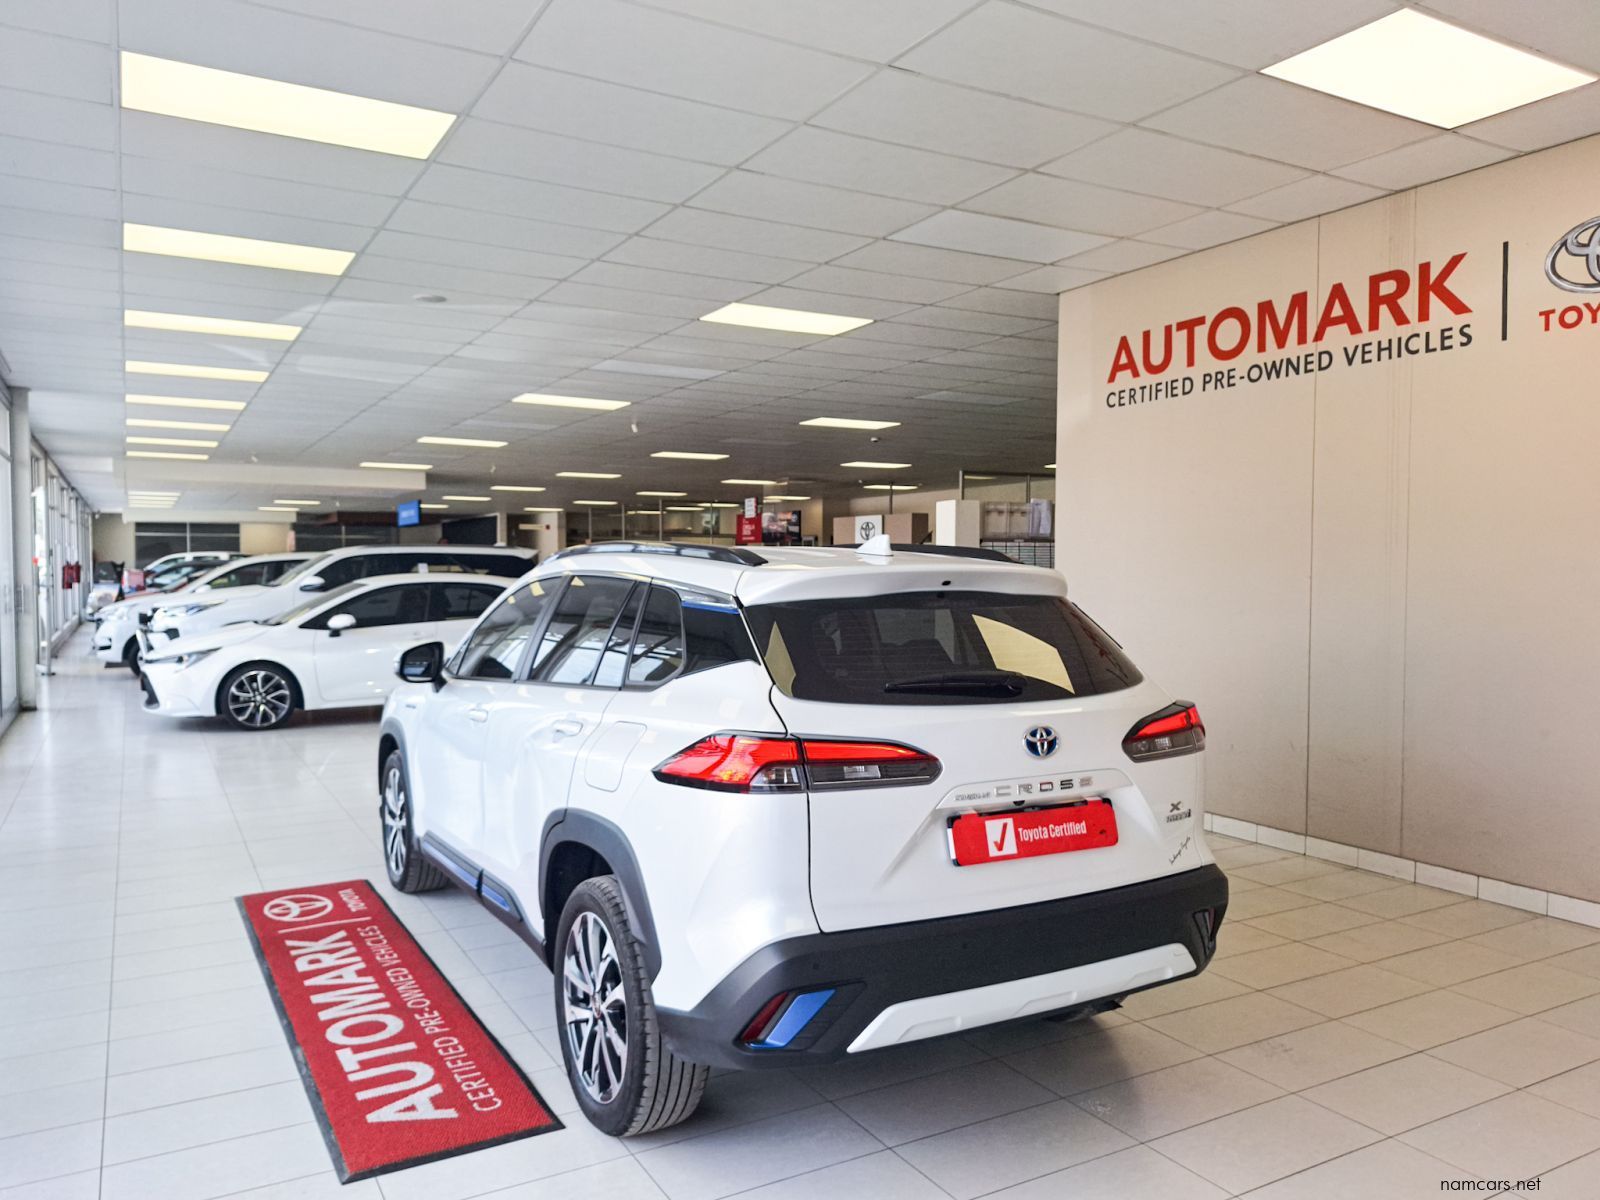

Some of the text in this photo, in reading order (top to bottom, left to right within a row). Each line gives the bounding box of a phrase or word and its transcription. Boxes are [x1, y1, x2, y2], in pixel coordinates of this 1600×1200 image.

[1106, 323, 1473, 409] CERTIFIED PRE-OWNED VEHICLES
[1107, 252, 1473, 384] AUTOMARK
[993, 776, 1093, 798] CROSS
[1017, 819, 1087, 843] Toyota Certified
[285, 930, 459, 1124] AUTOMARK
[359, 924, 502, 1114] CERTIFIED PRE-OWNED VEHICLES
